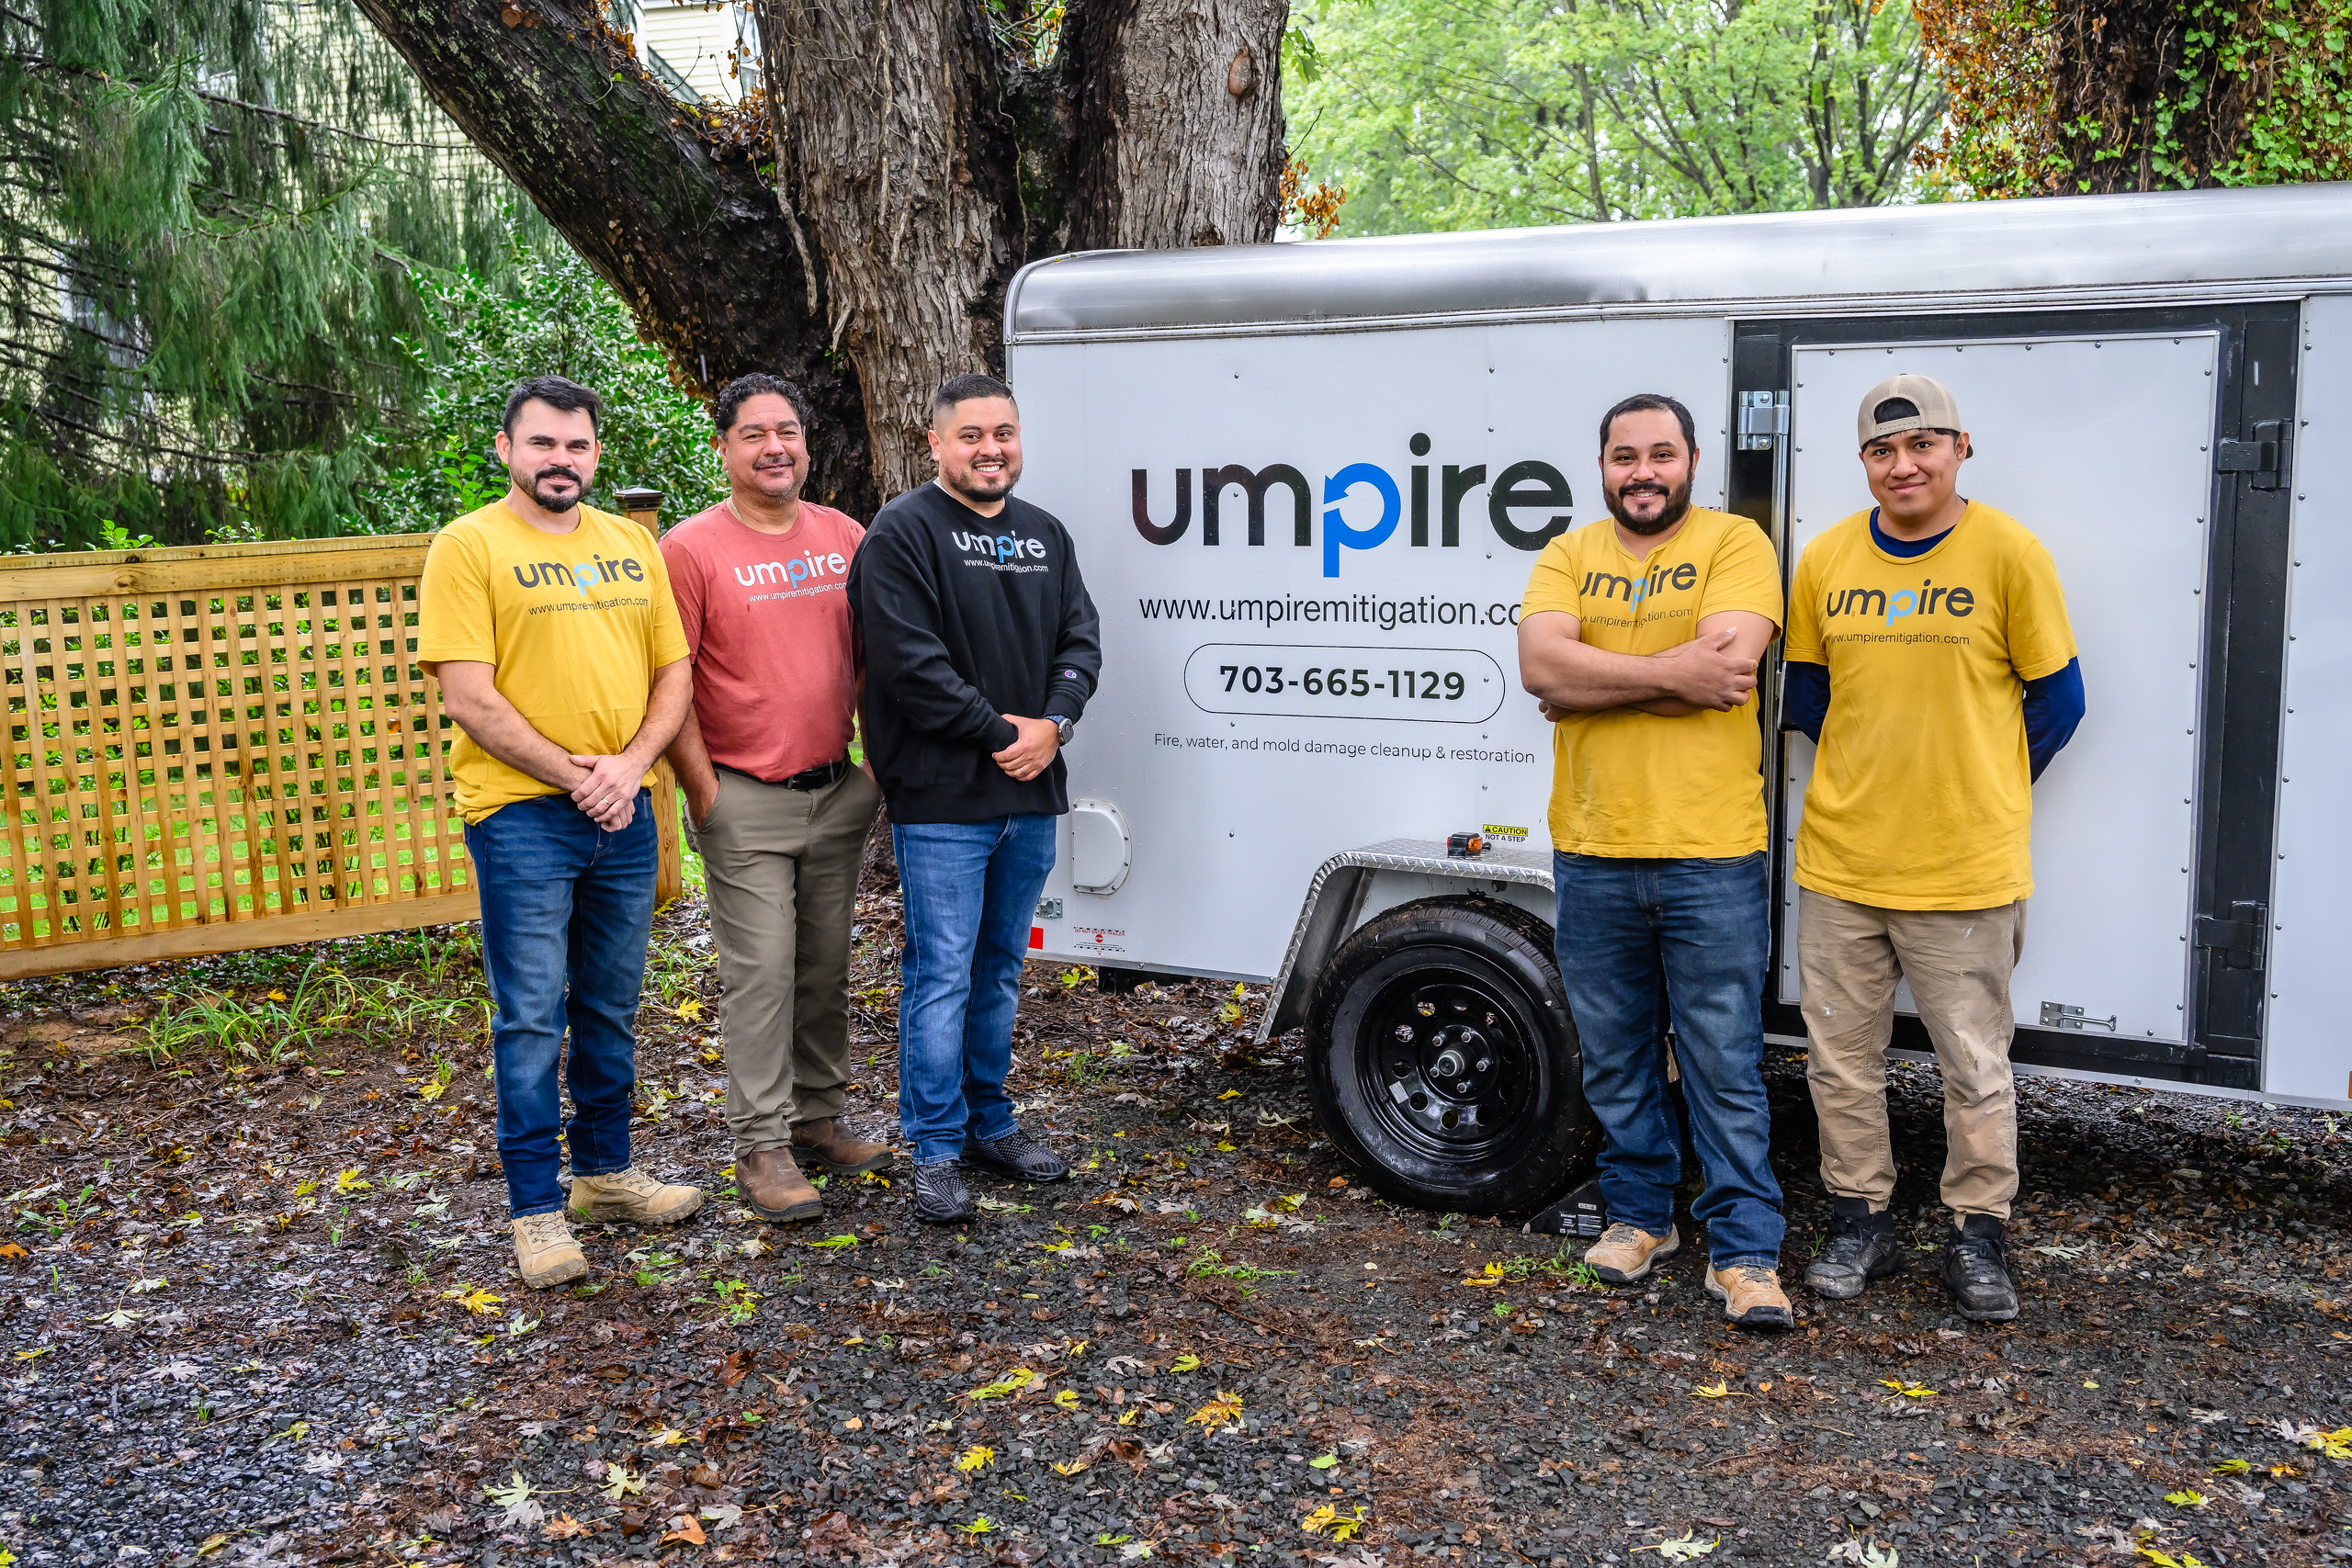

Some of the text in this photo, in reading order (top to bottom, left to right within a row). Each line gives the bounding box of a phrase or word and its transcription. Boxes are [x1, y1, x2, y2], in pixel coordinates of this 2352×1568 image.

[1131, 433, 1573, 578] umpire
[952, 530, 1046, 564] umpire
[513, 554, 644, 596] umpire
[734, 549, 847, 589] umpire
[1580, 562, 1697, 612] umpire
[1139, 592, 1521, 632] www.umpiremitigation.co
[1826, 579, 1974, 626] umpire
[1220, 665, 1465, 701] 703-665-1129
[1154, 733, 1535, 763] Fire, water, and mold damage cleanup & restoration
[1492, 827, 1527, 835] CAUTION
